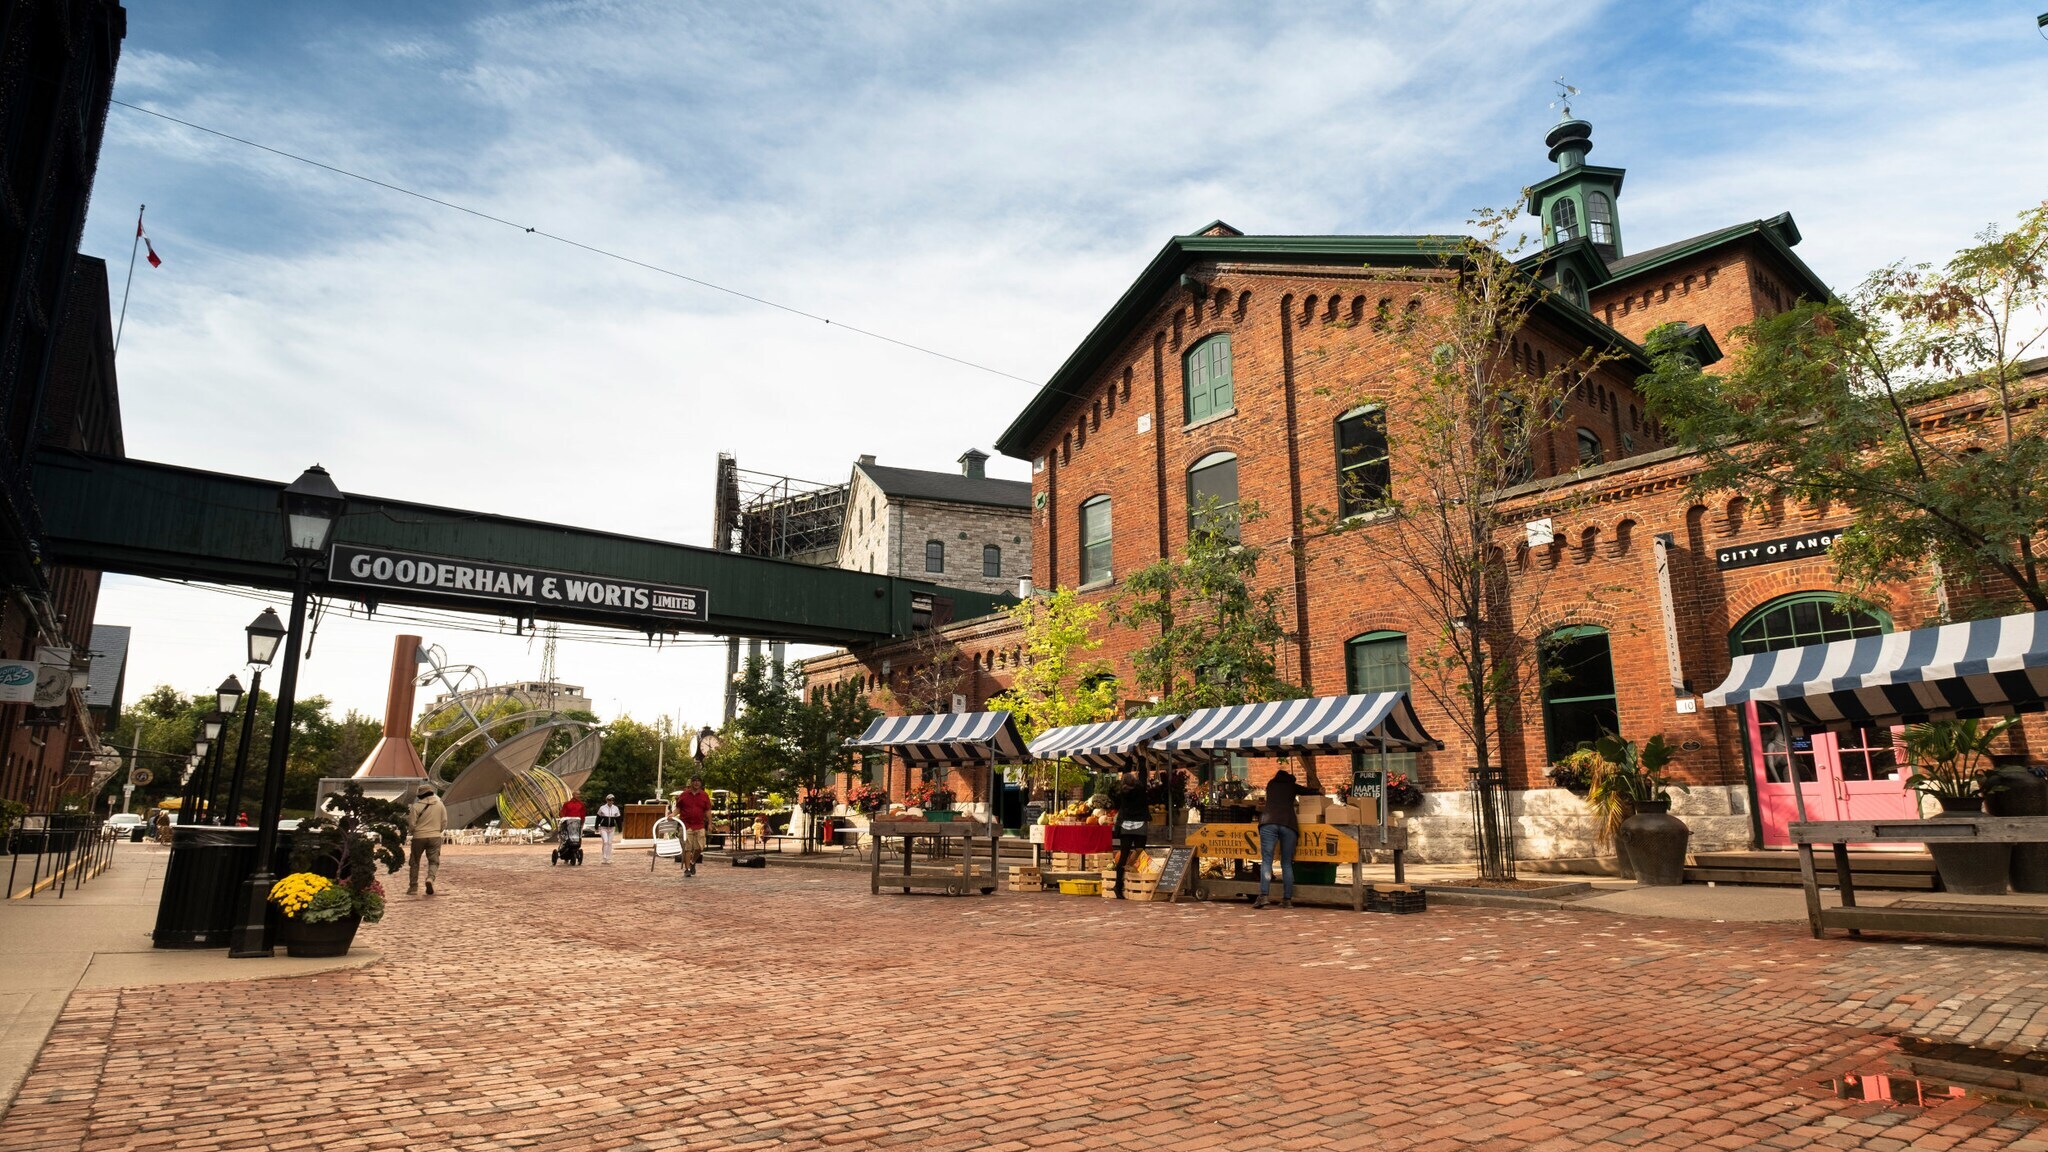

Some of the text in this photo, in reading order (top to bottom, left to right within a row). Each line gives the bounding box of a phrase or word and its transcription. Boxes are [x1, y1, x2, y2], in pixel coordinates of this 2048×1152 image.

[1720, 534, 1843, 562] CITY OF ANGE
[350, 554, 696, 610] GOODERHAM & WORTS LIMITED
[1684, 701, 1694, 711] 10
[1354, 784, 1381, 793] MAPLE
